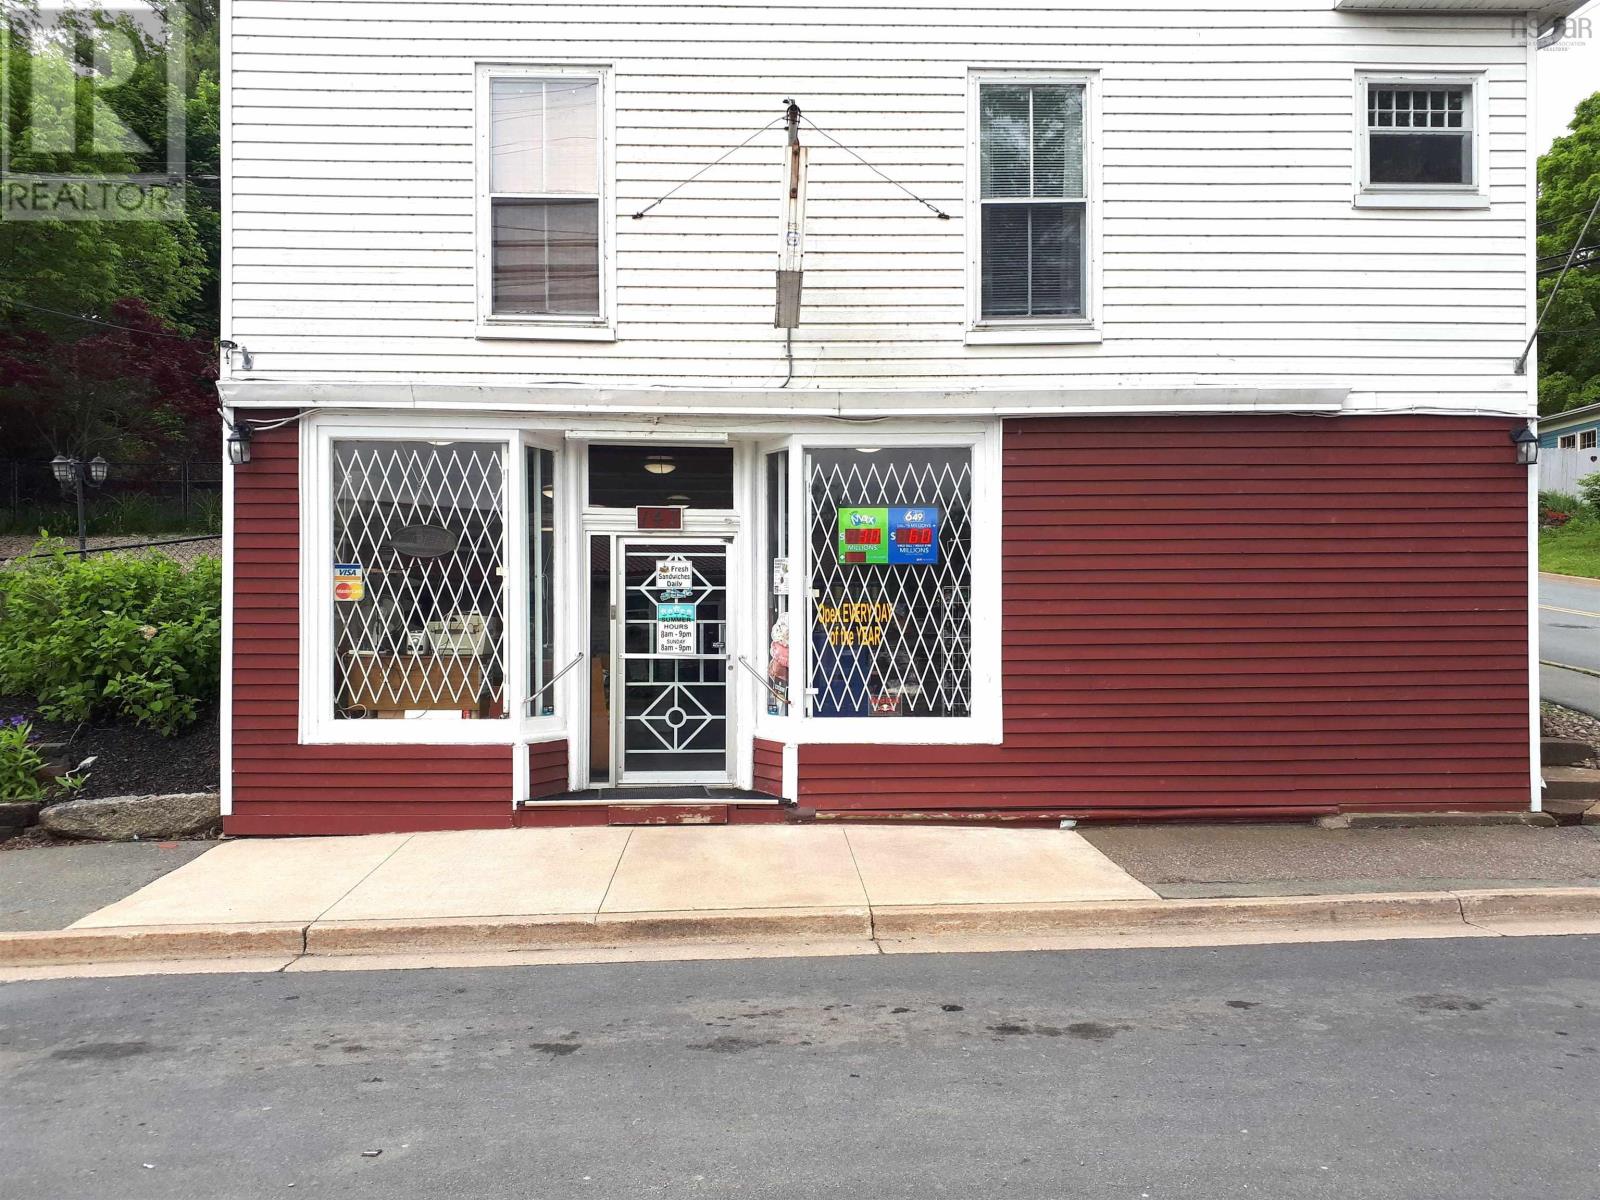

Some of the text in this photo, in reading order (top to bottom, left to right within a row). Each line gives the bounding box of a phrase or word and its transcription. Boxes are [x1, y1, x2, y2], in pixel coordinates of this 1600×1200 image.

[904, 510, 924, 521] 649
[909, 528, 932, 544] 60
[818, 603, 840, 624] Open
[830, 626, 839, 645] of
[856, 626, 881, 646] YEAR
